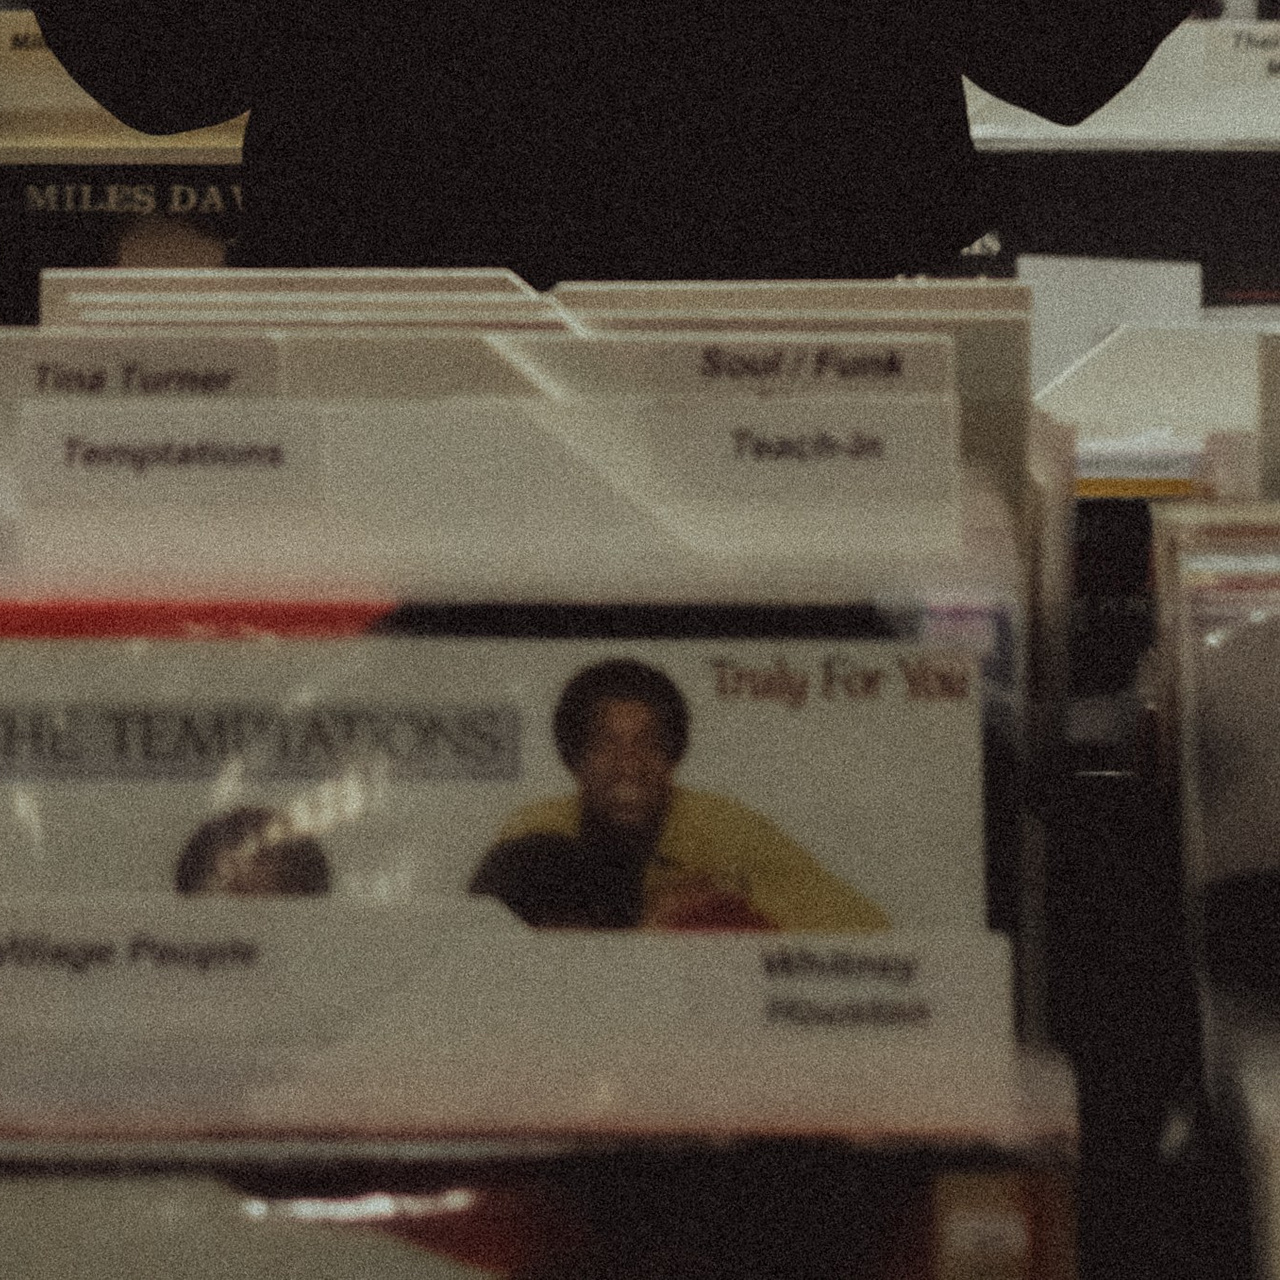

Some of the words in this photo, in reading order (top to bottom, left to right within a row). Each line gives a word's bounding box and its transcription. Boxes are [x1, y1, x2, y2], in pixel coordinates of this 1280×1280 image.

[24, 182, 157, 214] MILES
[35, 361, 108, 394] Tina
[122, 360, 237, 394] Turner
[64, 435, 287, 476] Temptations
[709, 655, 811, 710] Truly
[818, 655, 883, 701] For
[895, 657, 971, 701] You
[128, 933, 258, 973] People
